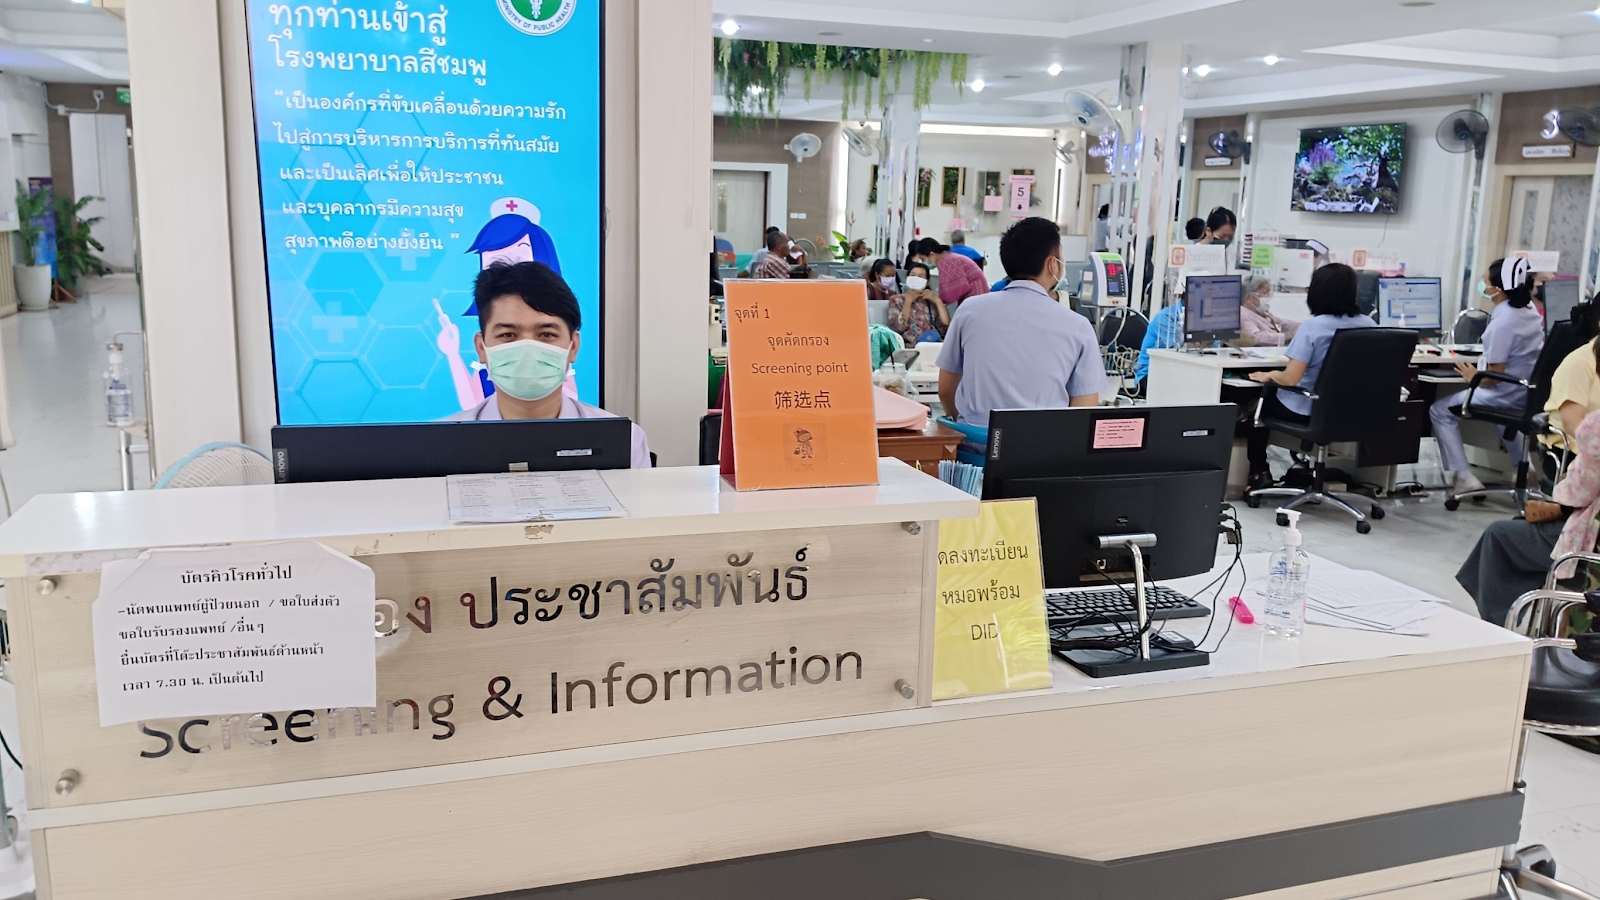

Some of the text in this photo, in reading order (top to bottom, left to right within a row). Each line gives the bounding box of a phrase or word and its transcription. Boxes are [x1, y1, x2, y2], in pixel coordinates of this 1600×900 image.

[533, 21, 555, 31] PUBLIC
[555, 2, 571, 24] HEALTH
[268, 34, 487, 85] โรงพยาบาลสีชมพู
[272, 121, 559, 153] ไปสู่การบริหารการบริการที่ทันสมัย
[280, 160, 504, 185] และเป็นเลิศเพื่อให้ประชาชน
[1017, 187, 1025, 197] 5
[282, 199, 464, 224] และบุคลากรมีความสุข
[284, 228, 444, 255] สุขภาพดีอย่างยั่งยืน
[734, 302, 770, 323] จุดที่ 1
[767, 332, 830, 351] จุดคัดกรอง
[751, 362, 849, 376] Screening point
[774, 389, 832, 410] 筛选点
[991, 430, 1001, 459] Lenovo
[277, 451, 286, 483] Lenovo
[181, 562, 292, 584] บัตรคิวโรคทั่วไป
[460, 543, 811, 630] ประชาสัมพันธ์
[942, 579, 1020, 605] หมอพร้อม
[279, 594, 340, 608] ขอใบส่งตัว
[119, 621, 225, 640] ขอใบรับรองแพทย์
[971, 622, 999, 641] DID
[121, 642, 324, 666] ยื่นบัตรที่โต๊ะประชาสัมพันธ์ด้านหน้า
[123, 670, 263, 691] เวลา 7.30 น. เป็นต้นไป
[483, 675, 524, 722] &
[551, 646, 863, 714] Information
